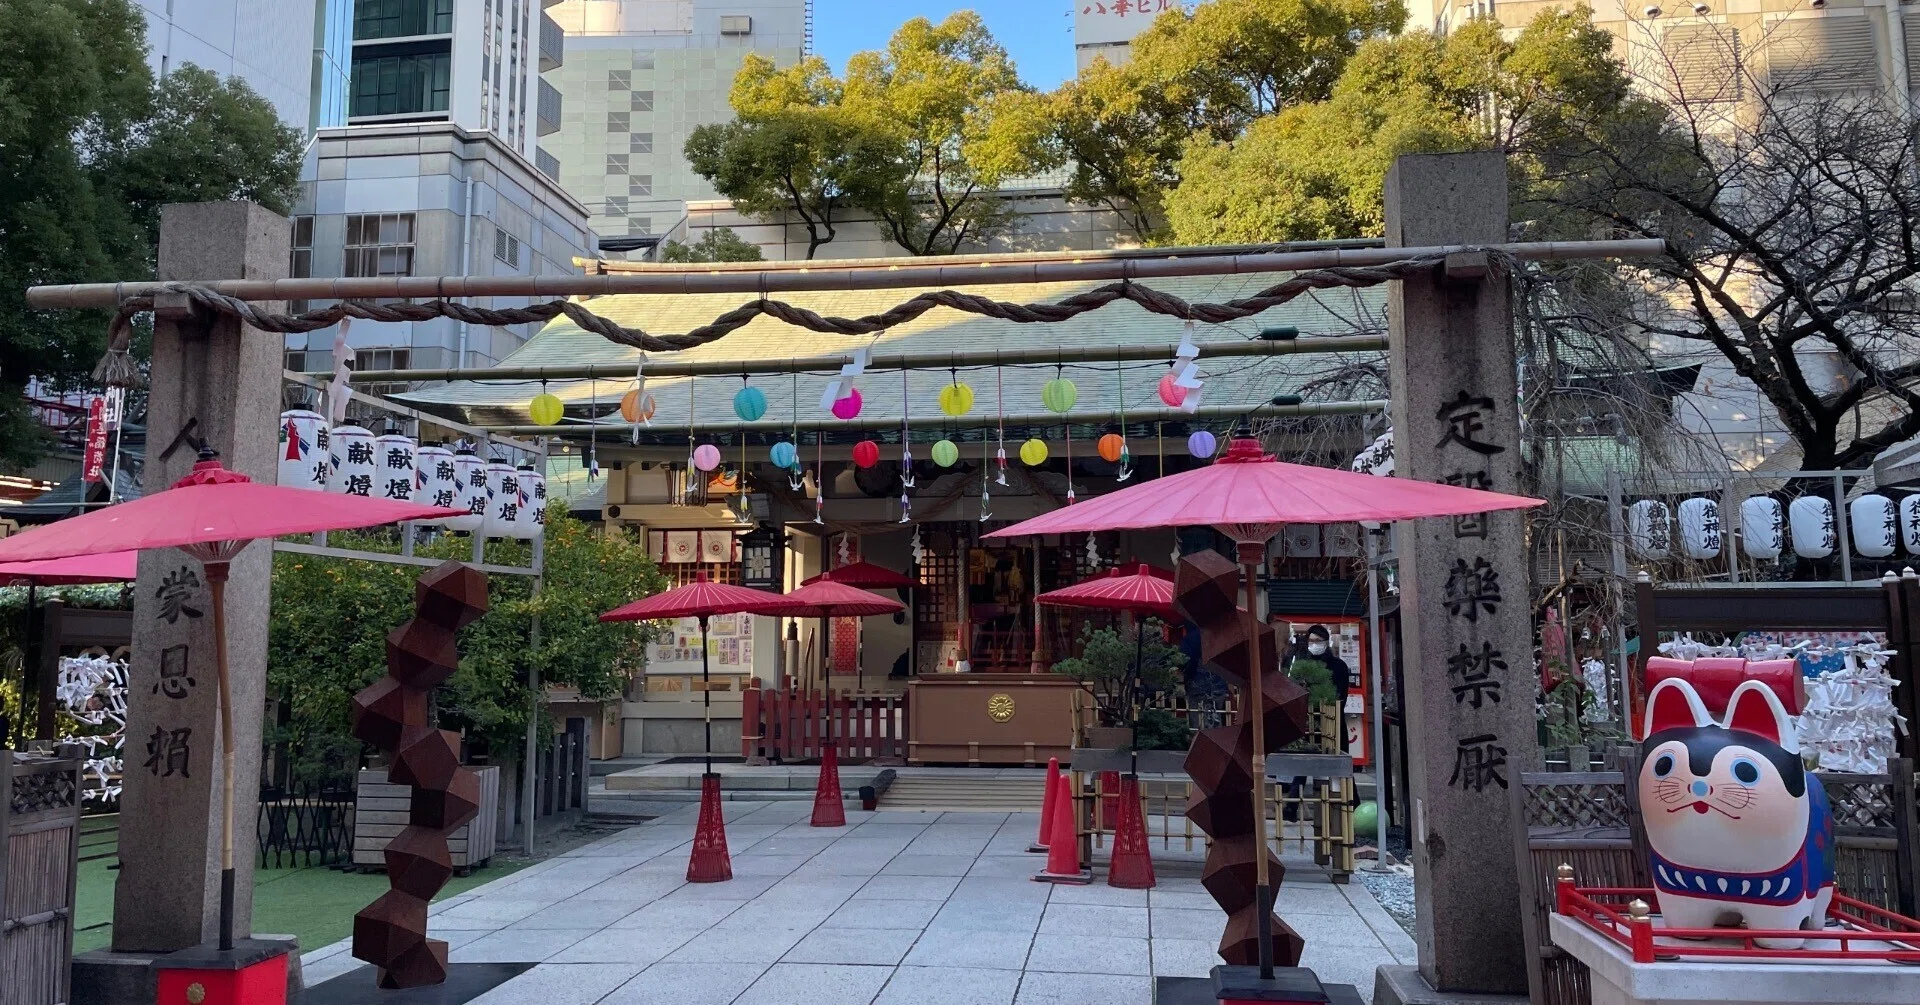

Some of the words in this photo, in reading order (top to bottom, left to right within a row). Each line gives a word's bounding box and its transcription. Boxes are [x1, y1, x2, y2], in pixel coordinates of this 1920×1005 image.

[345, 441, 375, 497] 献燈
[385, 447, 413, 500] 献燈
[434, 461, 455, 508] 献燈
[468, 468, 487, 516] 献燈
[498, 476, 518, 521] 献燈
[1702, 502, 1720, 549] 御神燈
